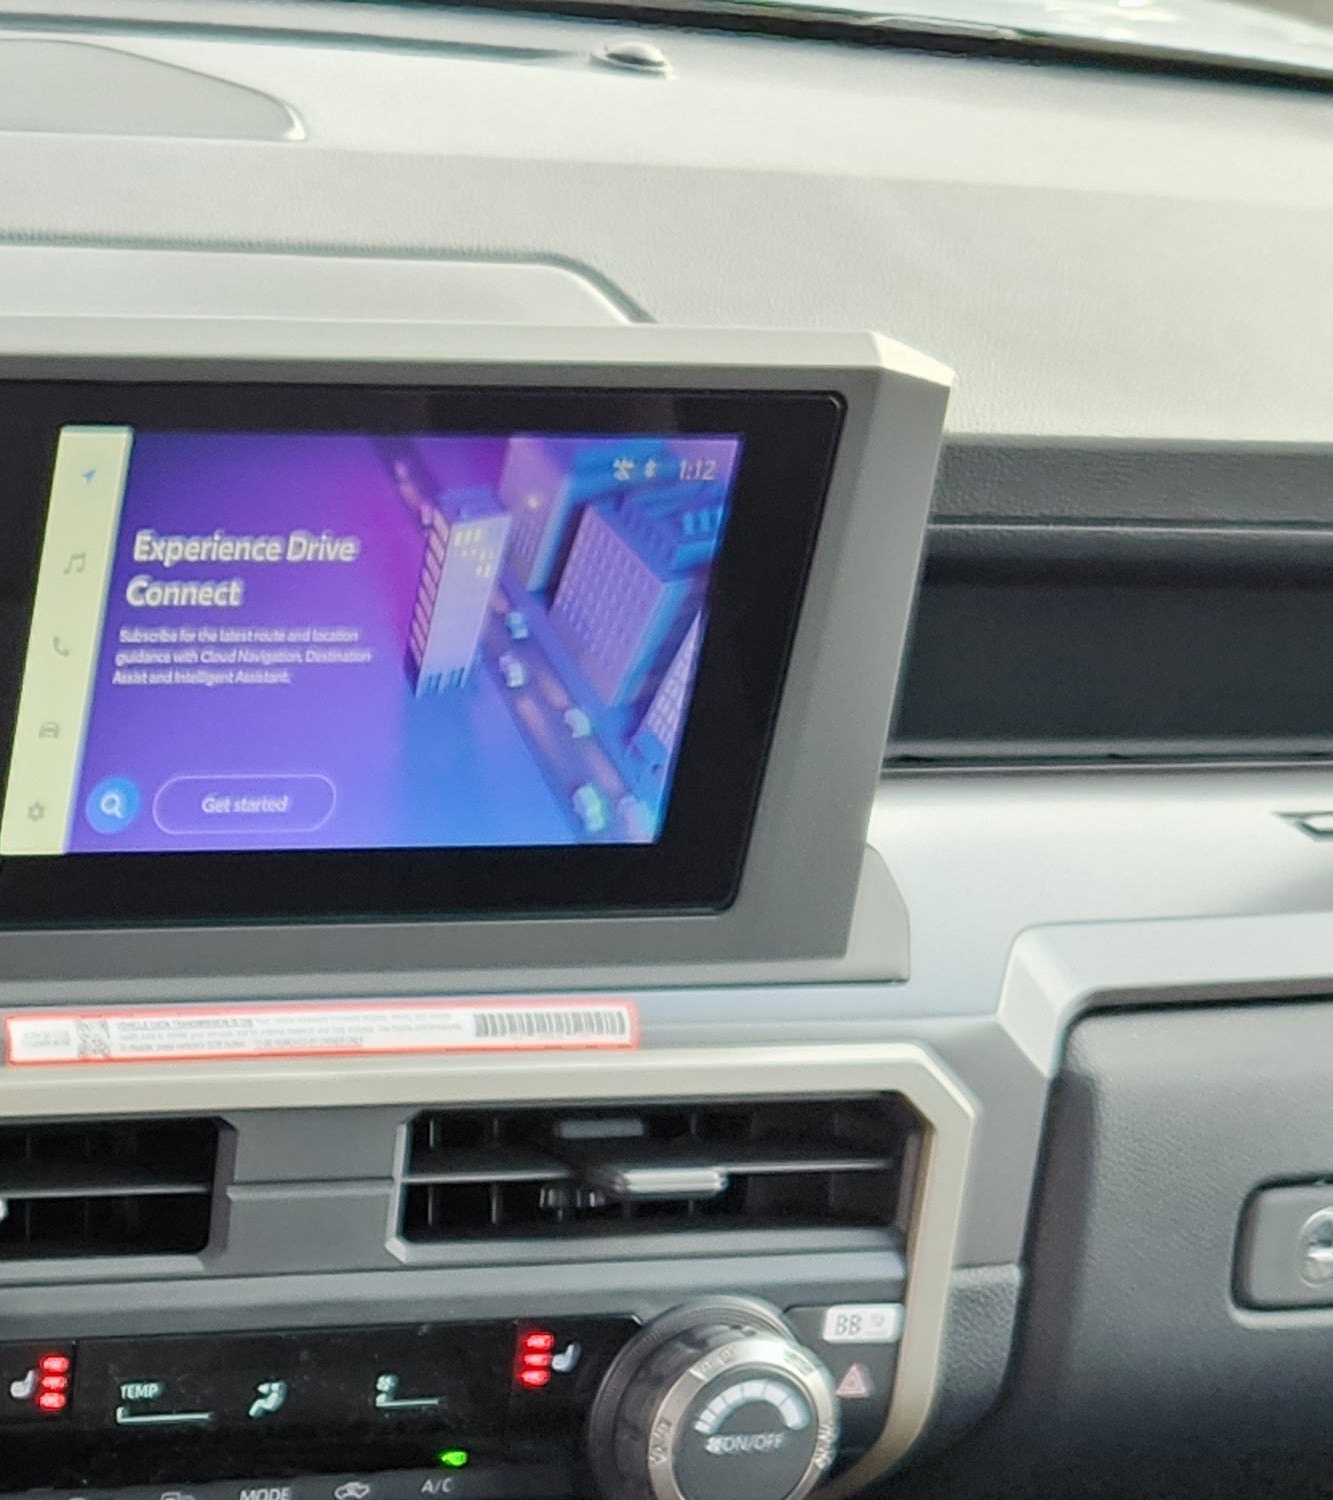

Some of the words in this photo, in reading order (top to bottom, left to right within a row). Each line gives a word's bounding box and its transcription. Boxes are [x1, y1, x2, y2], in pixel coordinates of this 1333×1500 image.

[679, 459, 717, 481] 1:12
[134, 532, 282, 567] Experience
[286, 532, 357, 562] Drive
[126, 577, 242, 606] Connect
[201, 796, 233, 813] Get
[233, 794, 290, 813] started
[120, 1382, 159, 1401] TEMP
[421, 1477, 454, 1494] A/C
